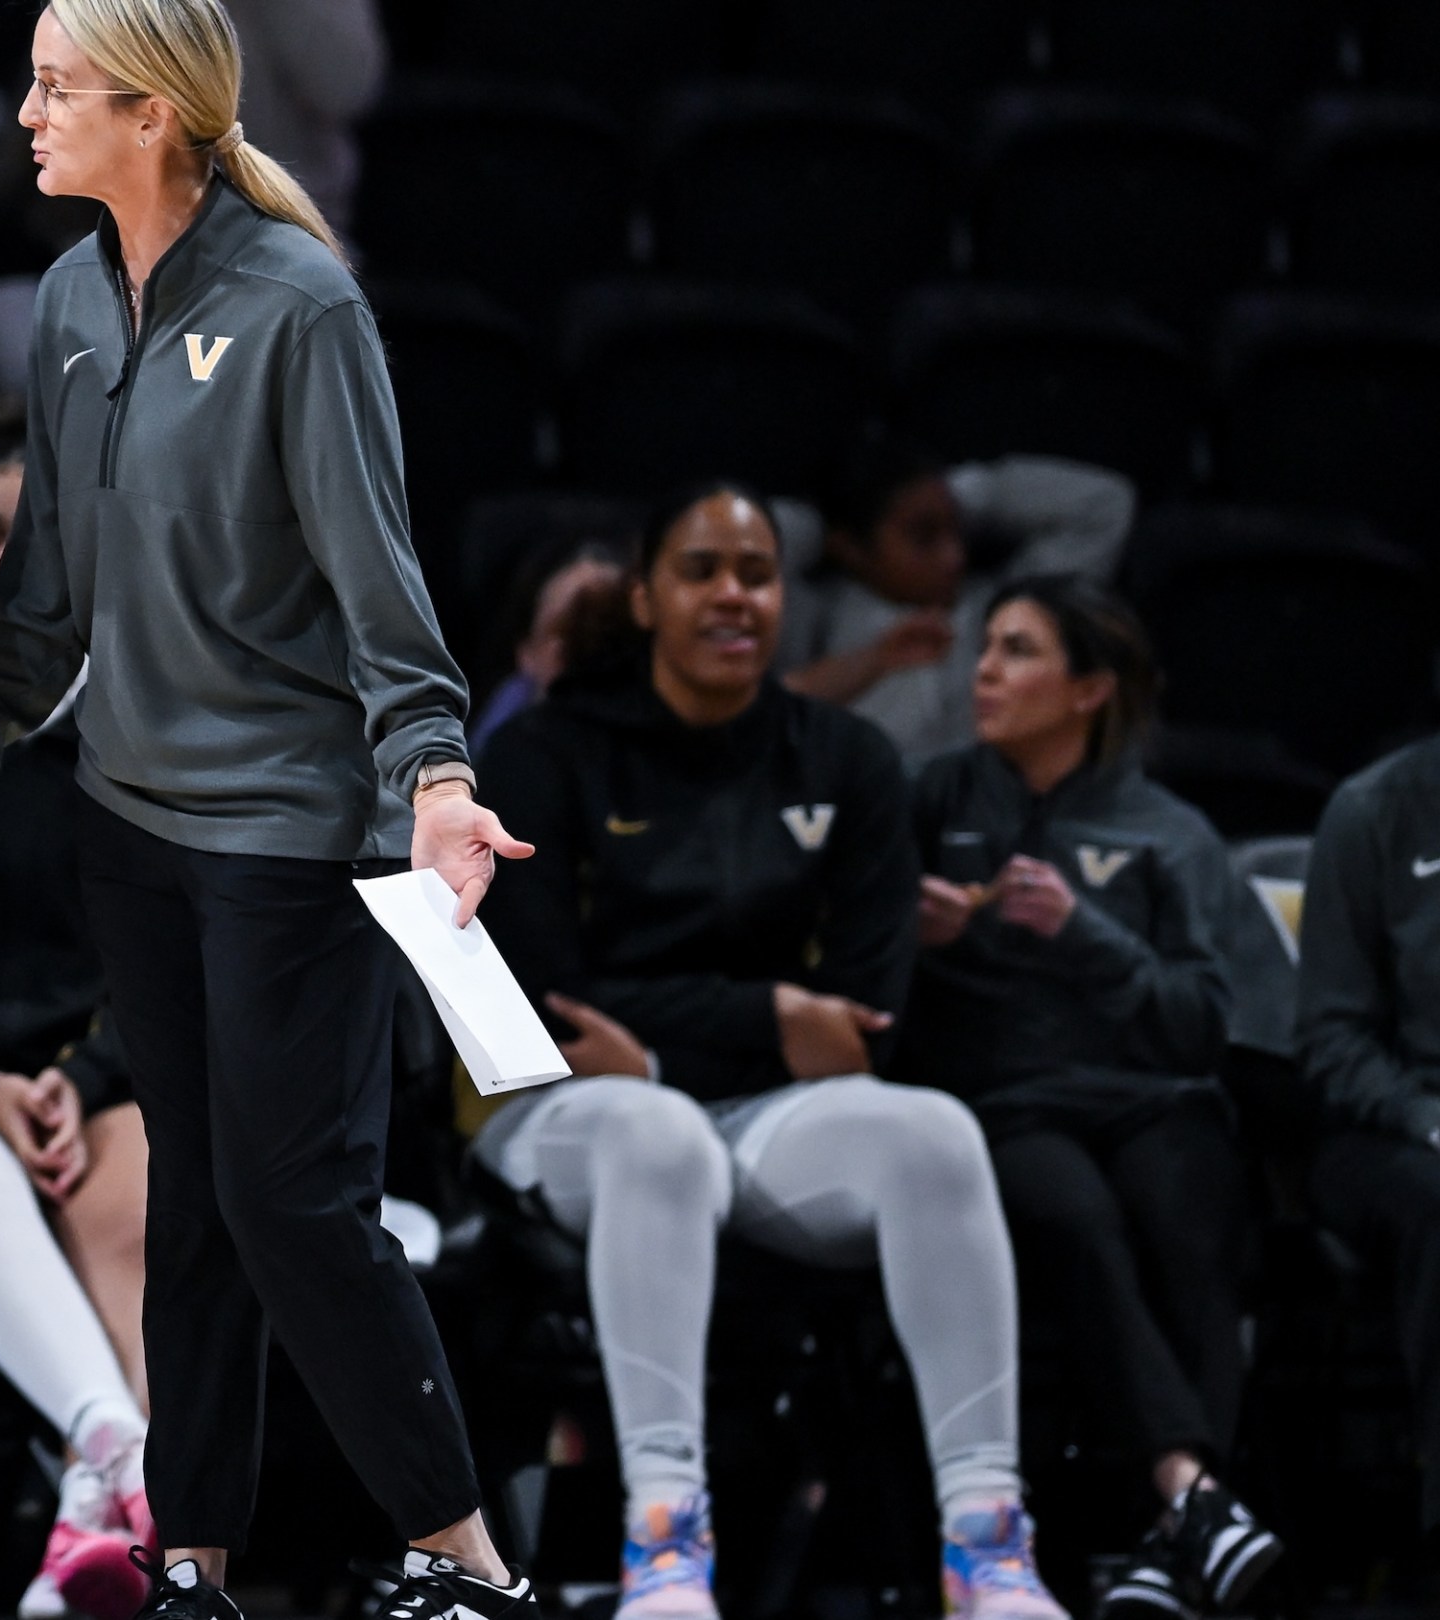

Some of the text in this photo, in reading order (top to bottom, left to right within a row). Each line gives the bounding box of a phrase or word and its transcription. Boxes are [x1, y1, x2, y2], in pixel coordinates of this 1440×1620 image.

[183, 333, 234, 381] V
[779, 803, 836, 851] V
[1076, 845, 1130, 887] V
